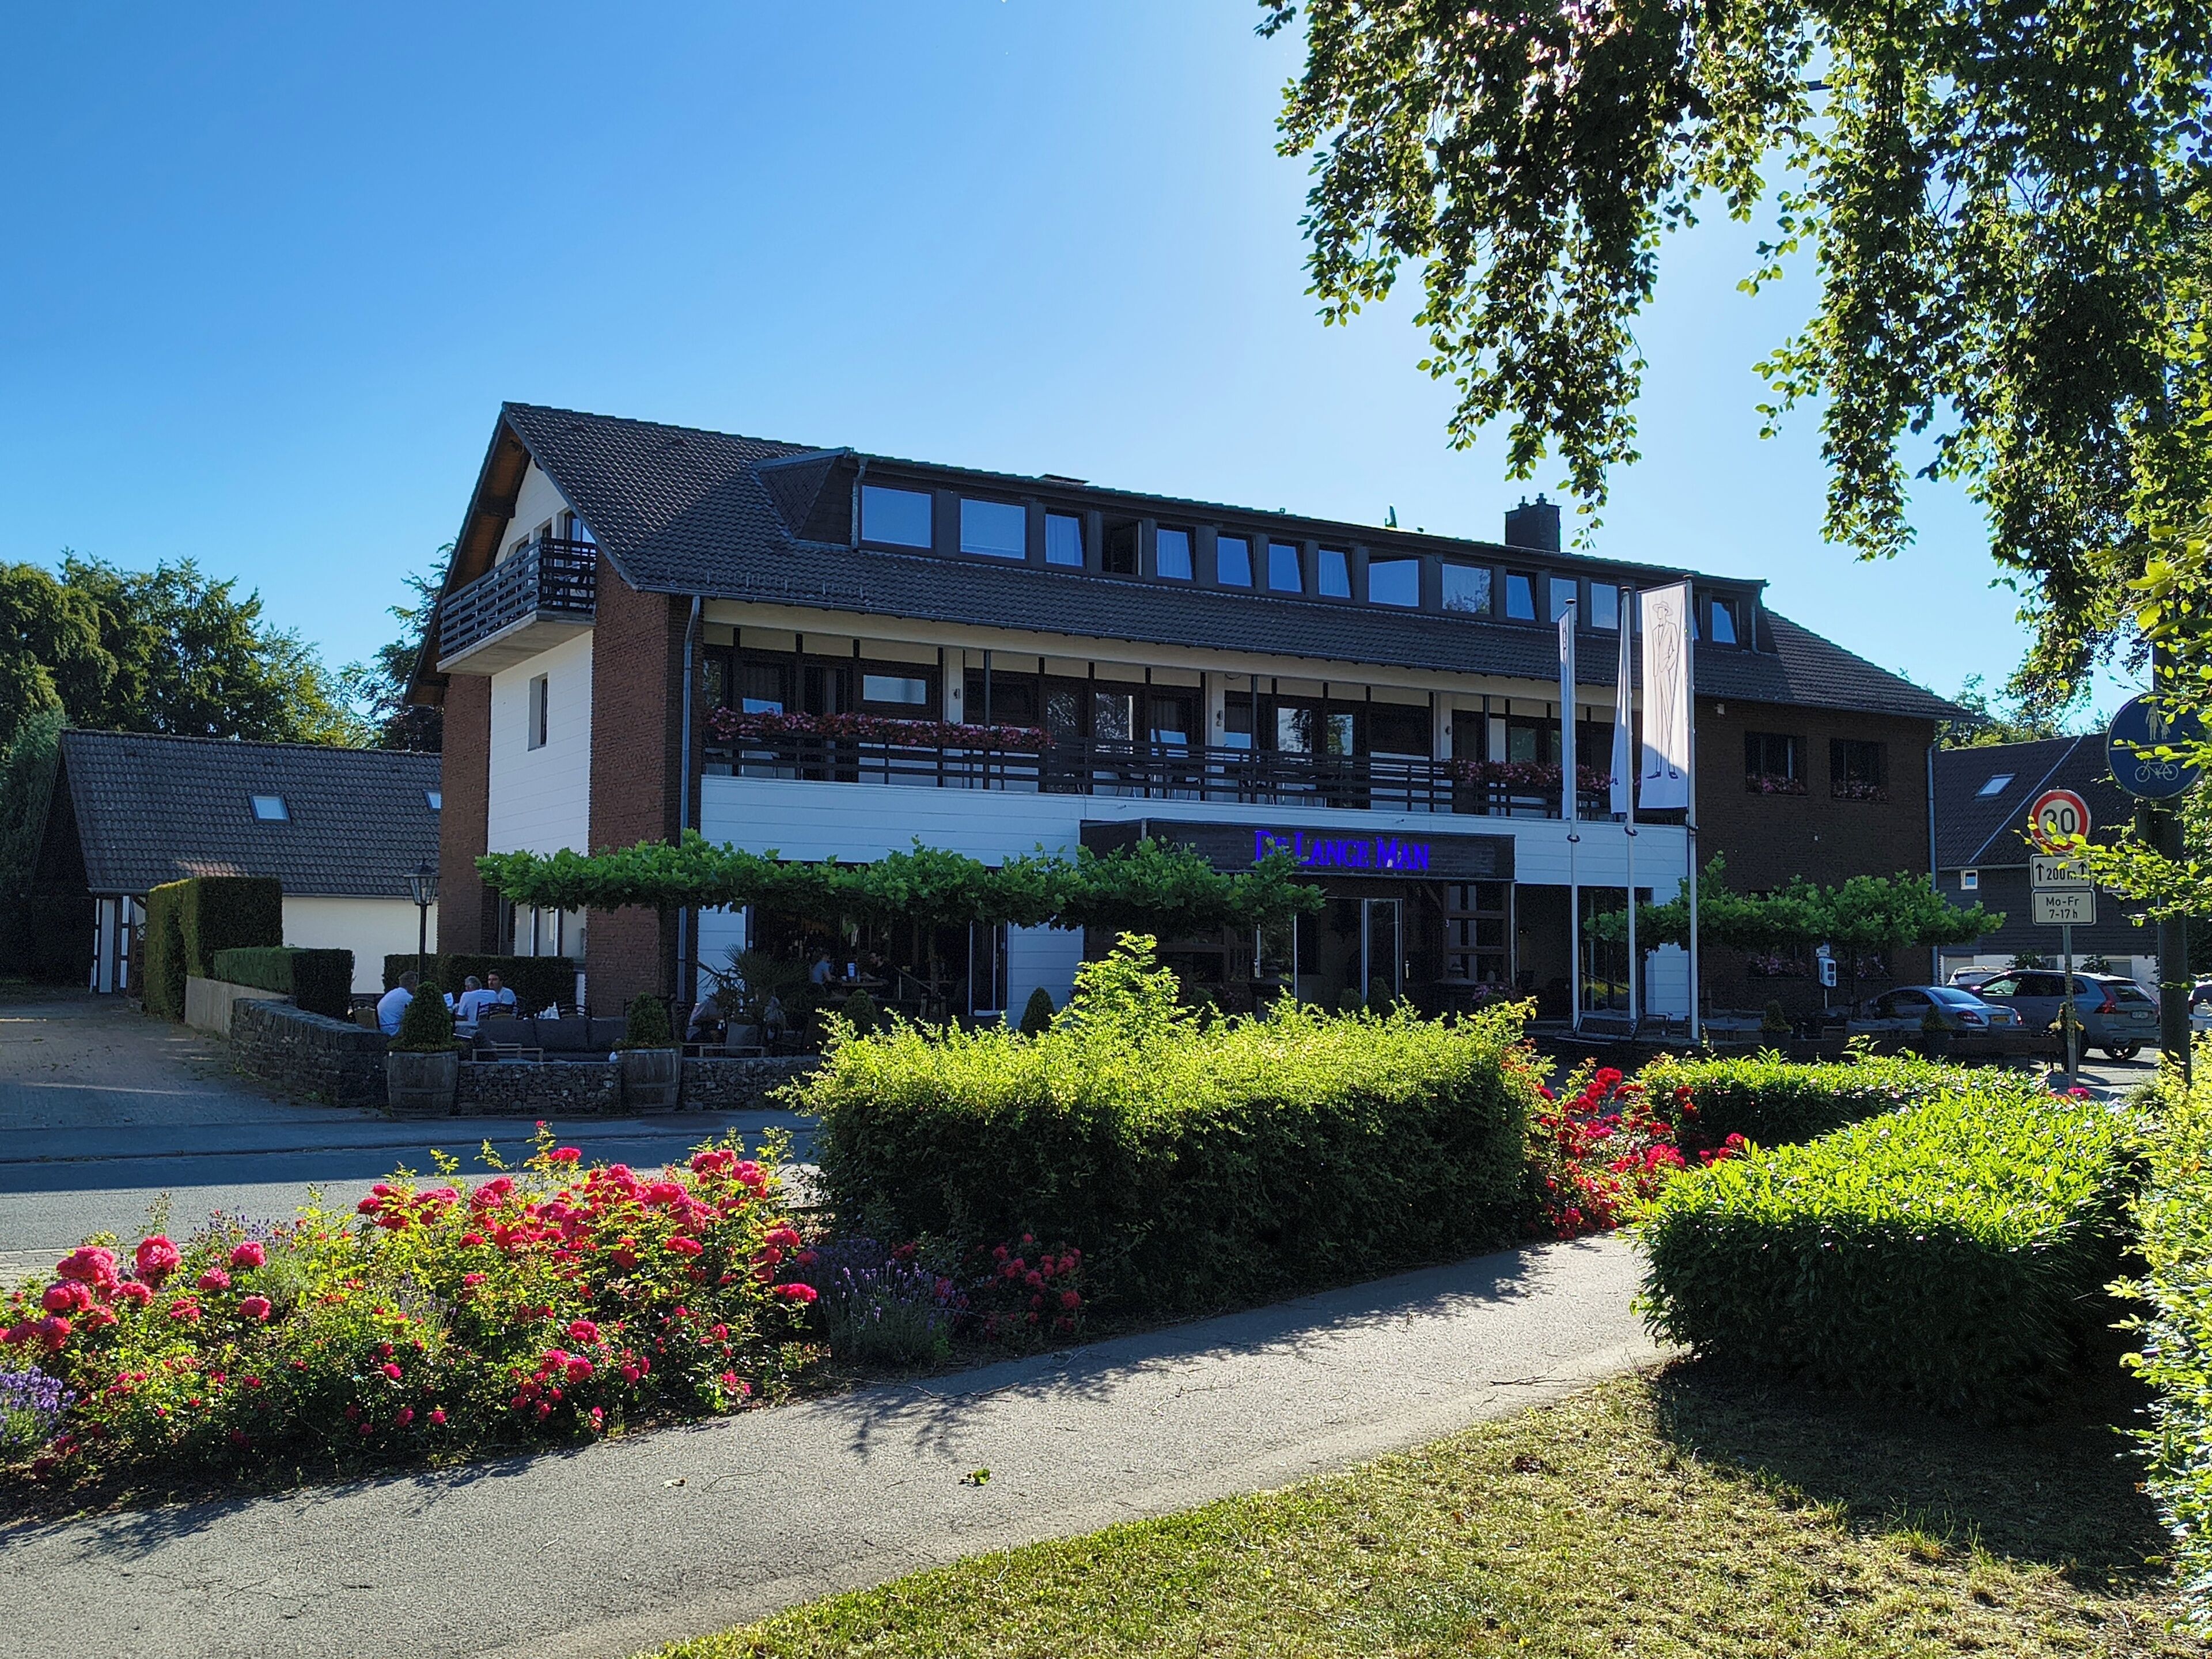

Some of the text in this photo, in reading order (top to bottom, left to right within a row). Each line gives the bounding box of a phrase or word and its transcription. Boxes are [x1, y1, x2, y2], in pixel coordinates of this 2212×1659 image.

[2043, 808, 2075, 835] 30
[2047, 868, 2065, 880] 200
[2046, 896, 2080, 906] Mo-Fr
[2049, 908, 2078, 919] 7-17 h
